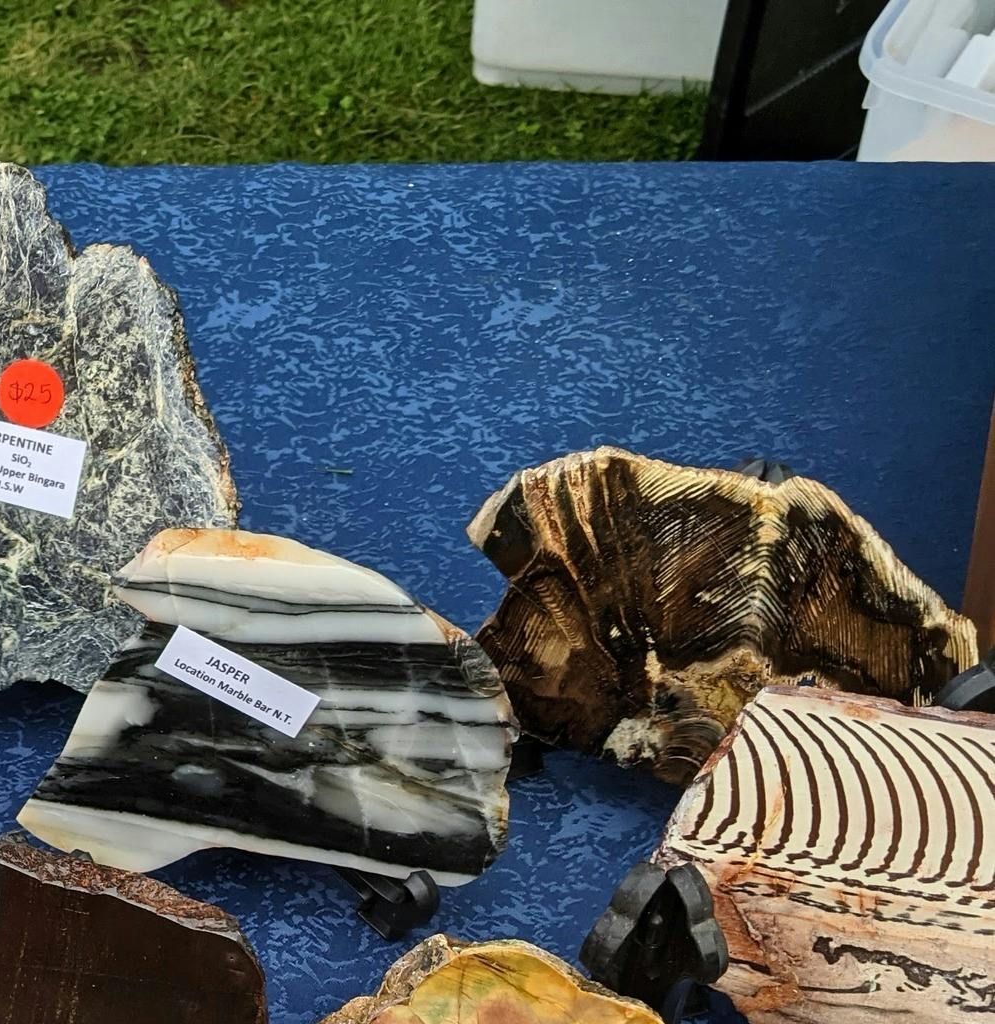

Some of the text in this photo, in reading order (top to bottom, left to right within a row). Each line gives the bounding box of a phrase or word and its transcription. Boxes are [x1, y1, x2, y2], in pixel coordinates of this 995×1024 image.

[7, 380, 52, 404] $25
[27, 472, 66, 490] Bingara
[204, 655, 251, 685] JASPER
[173, 658, 293, 726] Location Marble Bar N.T.
